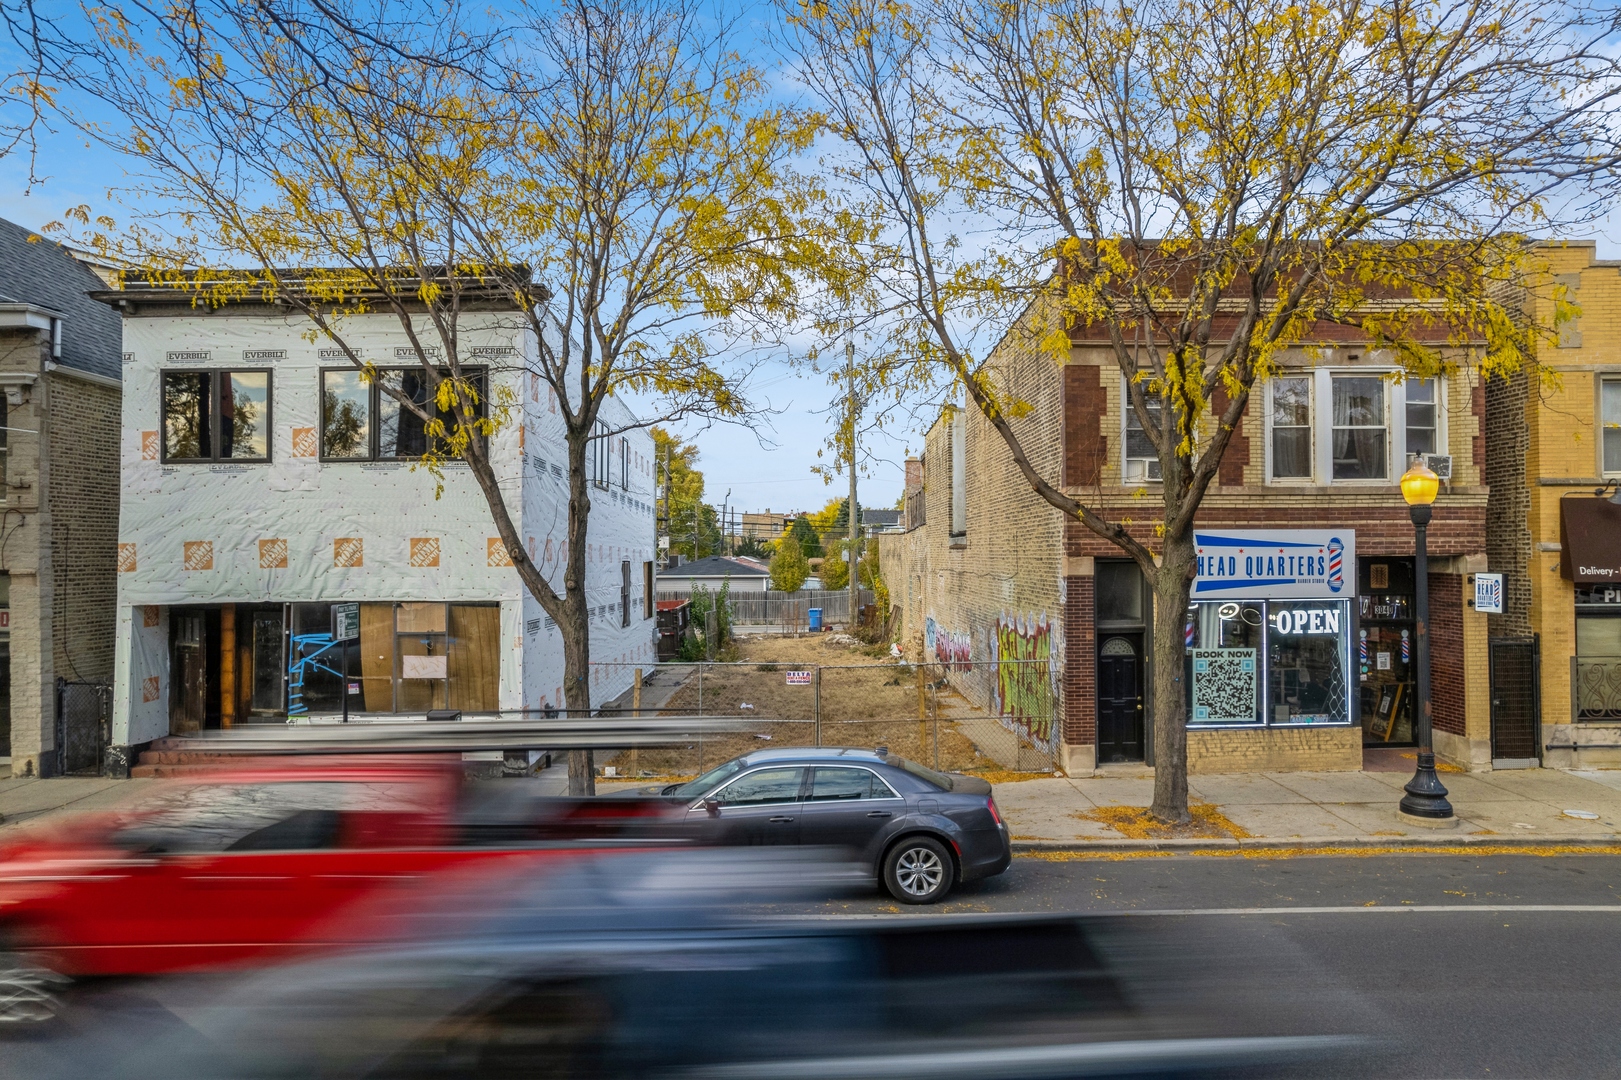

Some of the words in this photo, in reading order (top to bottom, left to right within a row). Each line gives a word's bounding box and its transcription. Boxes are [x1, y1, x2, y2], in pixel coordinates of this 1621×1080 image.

[184, 540, 212, 570] HOME
[188, 544, 198, 556] THE
[260, 539, 287, 568] HOME
[262, 542, 273, 553] THE
[334, 538, 363, 567] HOME
[338, 541, 349, 552] THE
[410, 538, 439, 567] HOME
[414, 541, 425, 552] THE
[196, 552, 213, 570] DEPOT
[270, 549, 287, 568] DEPOT
[345, 549, 363, 567] DEPOT
[421, 549, 439, 567] DEPOT
[1197, 556, 1236, 576] HEAD
[1246, 556, 1324, 578] QUARTERS
[1580, 566, 1613, 577] Delivery
[1478, 584, 1493, 595] HEAD
[1375, 606, 1393, 614] 3040
[1276, 609, 1340, 634] OPEN
